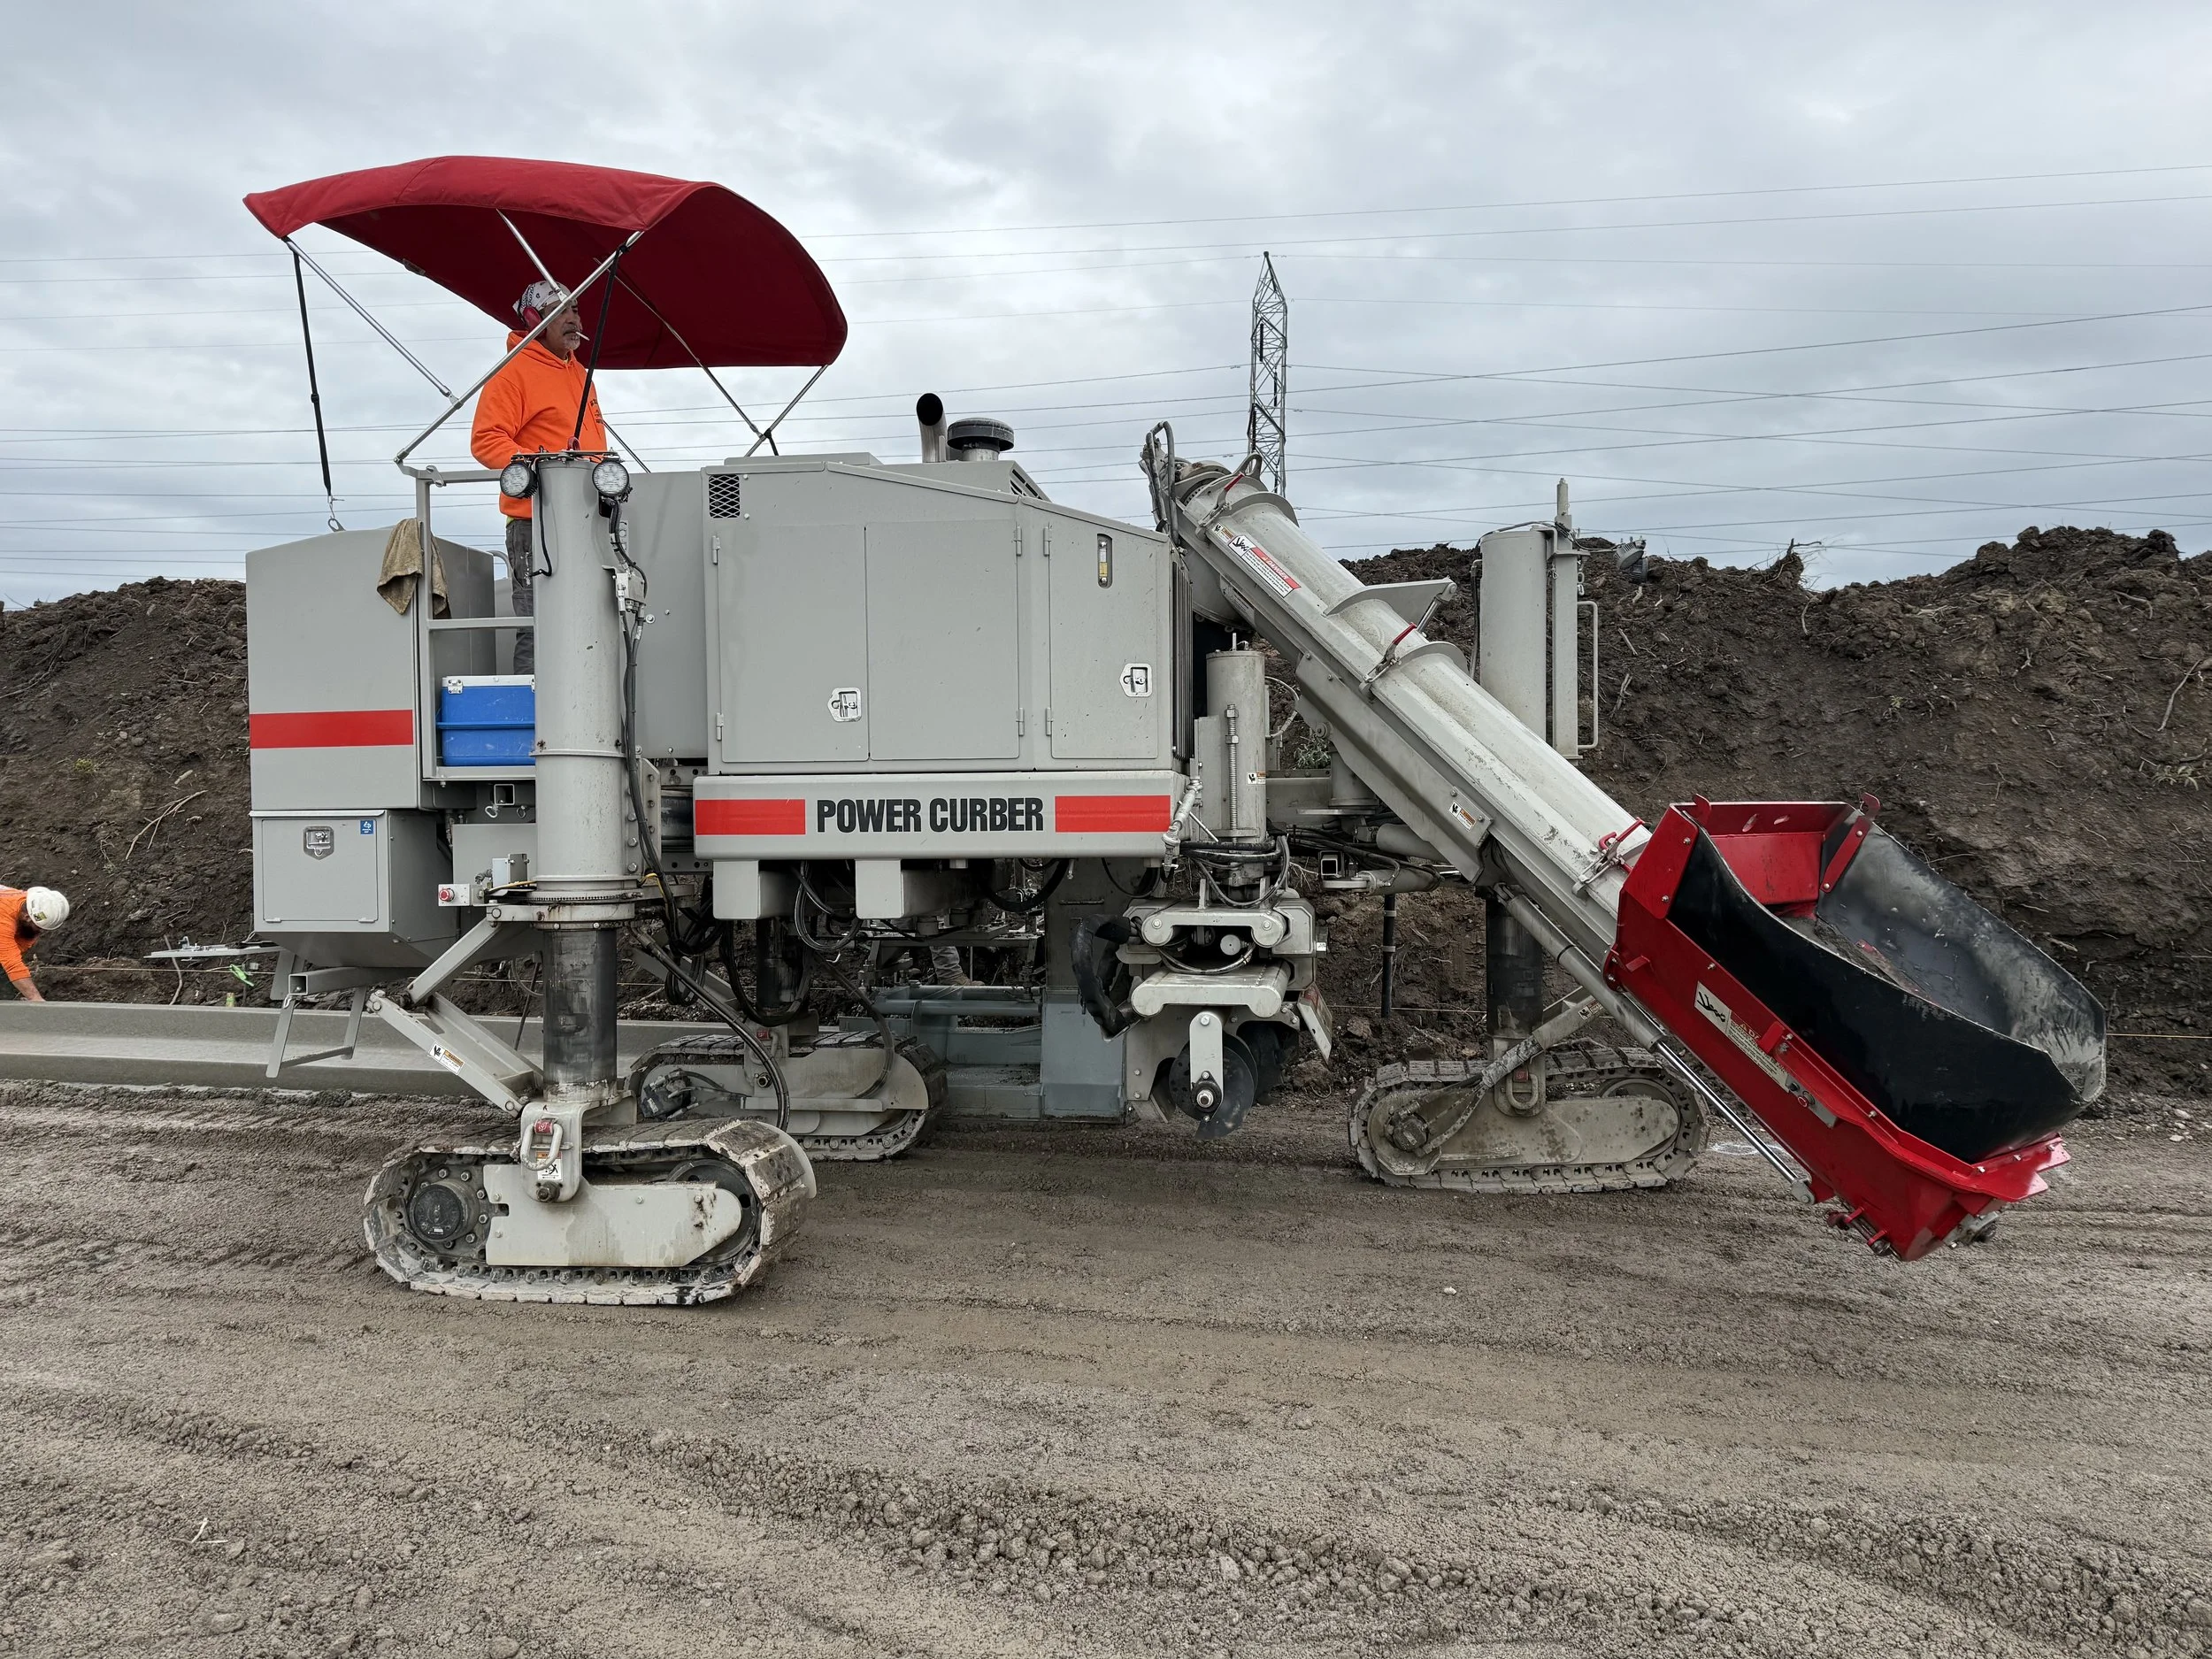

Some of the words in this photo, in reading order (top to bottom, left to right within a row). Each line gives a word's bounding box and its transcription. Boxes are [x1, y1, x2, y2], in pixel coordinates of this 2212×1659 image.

[1266, 559, 1289, 580] DANGER
[817, 798, 922, 833] POWER
[929, 797, 1044, 833] CURBER
